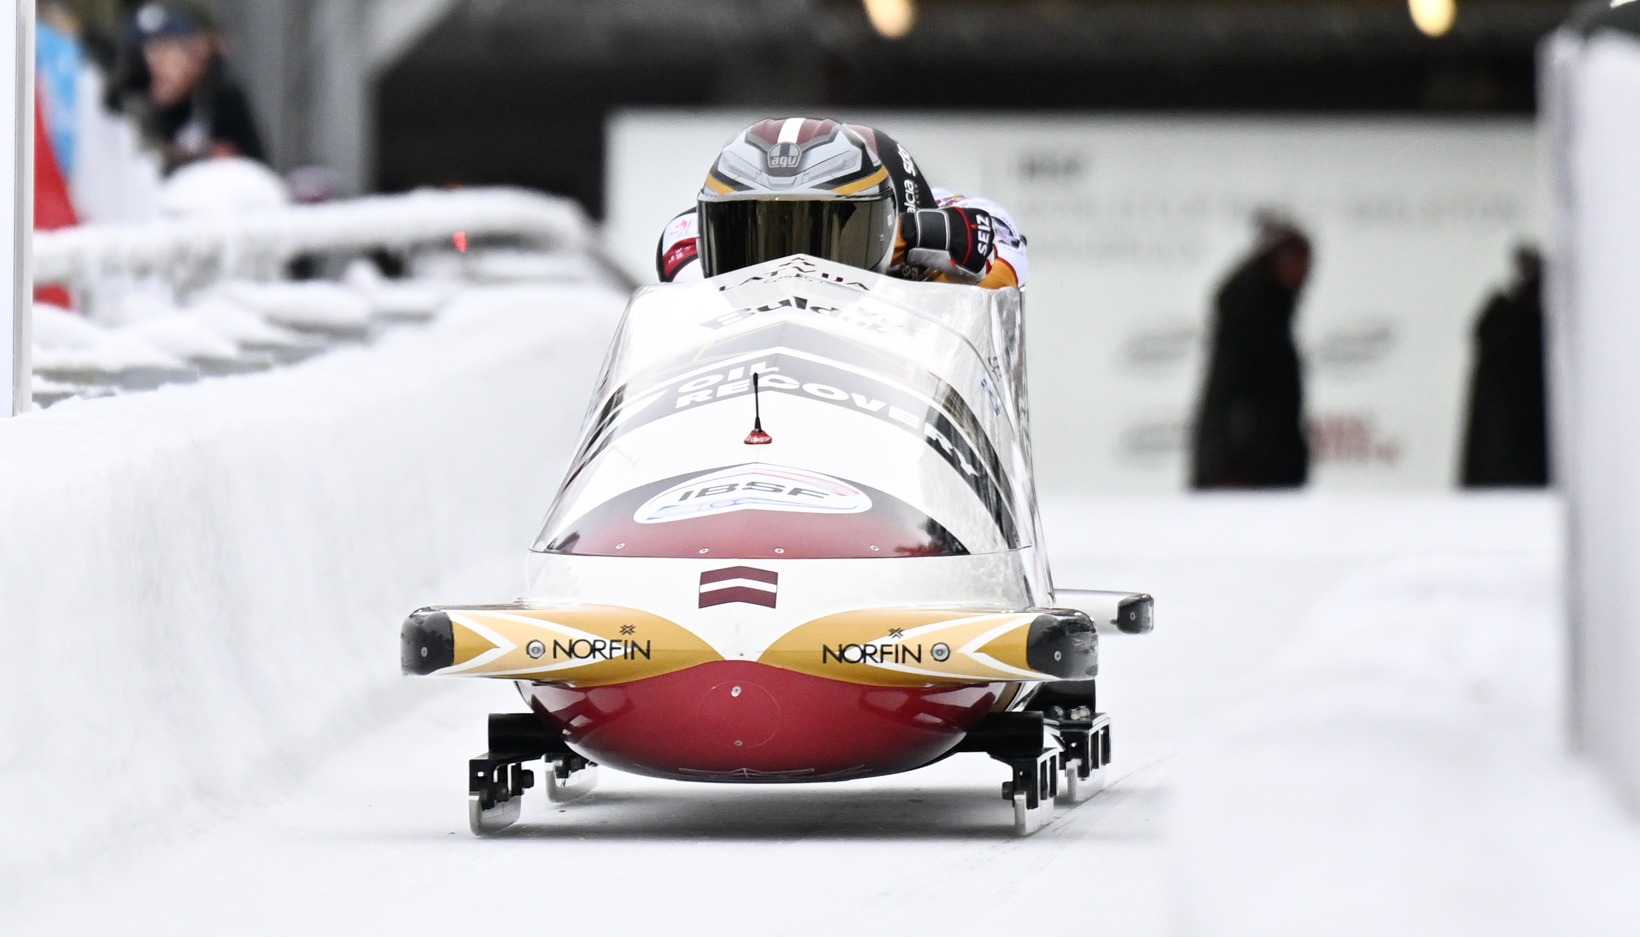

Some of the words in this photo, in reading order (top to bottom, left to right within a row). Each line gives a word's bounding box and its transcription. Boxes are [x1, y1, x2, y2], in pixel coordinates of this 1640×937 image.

[770, 155, 798, 168] agv
[903, 179, 916, 214] alcia
[976, 214, 991, 256] SEIZ
[678, 361, 779, 392] OIL
[675, 374, 979, 478] RECOVERY
[678, 481, 830, 502] IBSF
[553, 639, 651, 660] NORFIN
[822, 643, 922, 664] NORFIN
